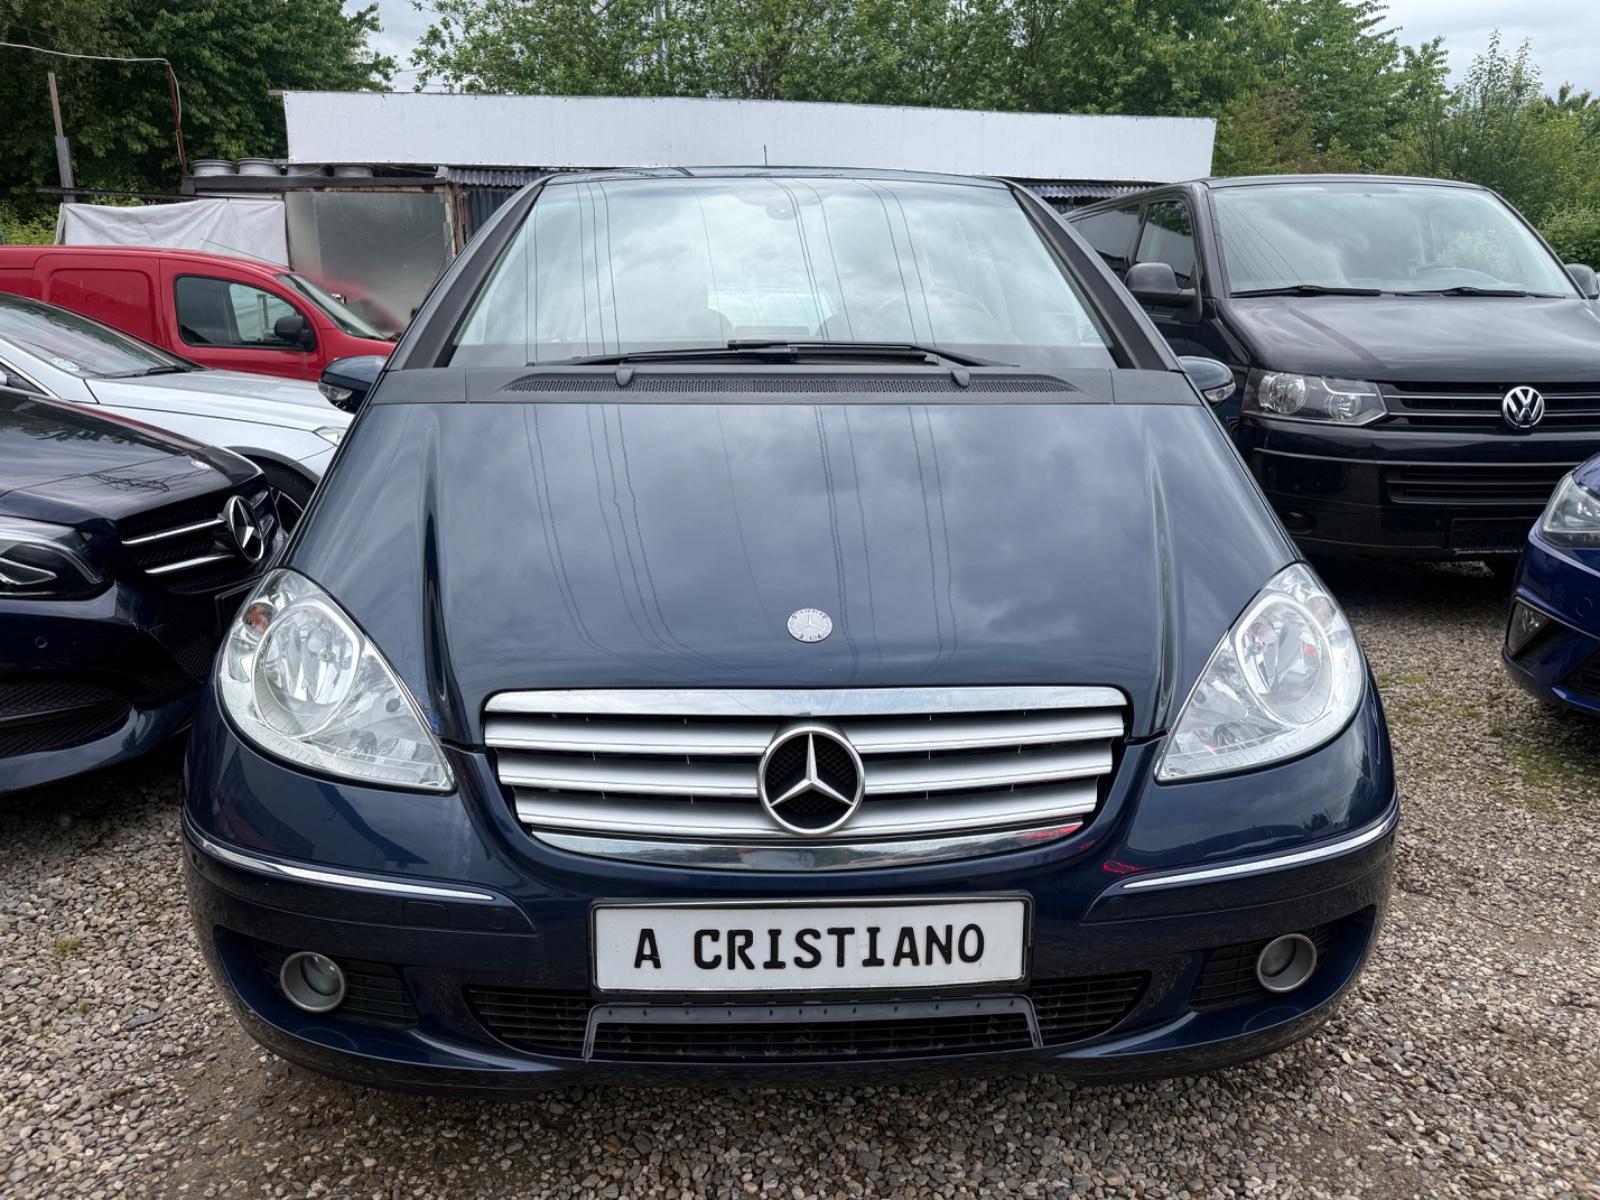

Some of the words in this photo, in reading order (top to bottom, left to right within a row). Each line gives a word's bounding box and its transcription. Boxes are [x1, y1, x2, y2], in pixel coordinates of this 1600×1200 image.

[1503, 386, 1545, 429] VW
[633, 928, 662, 970] A
[693, 923, 985, 970] CRISTIANO
